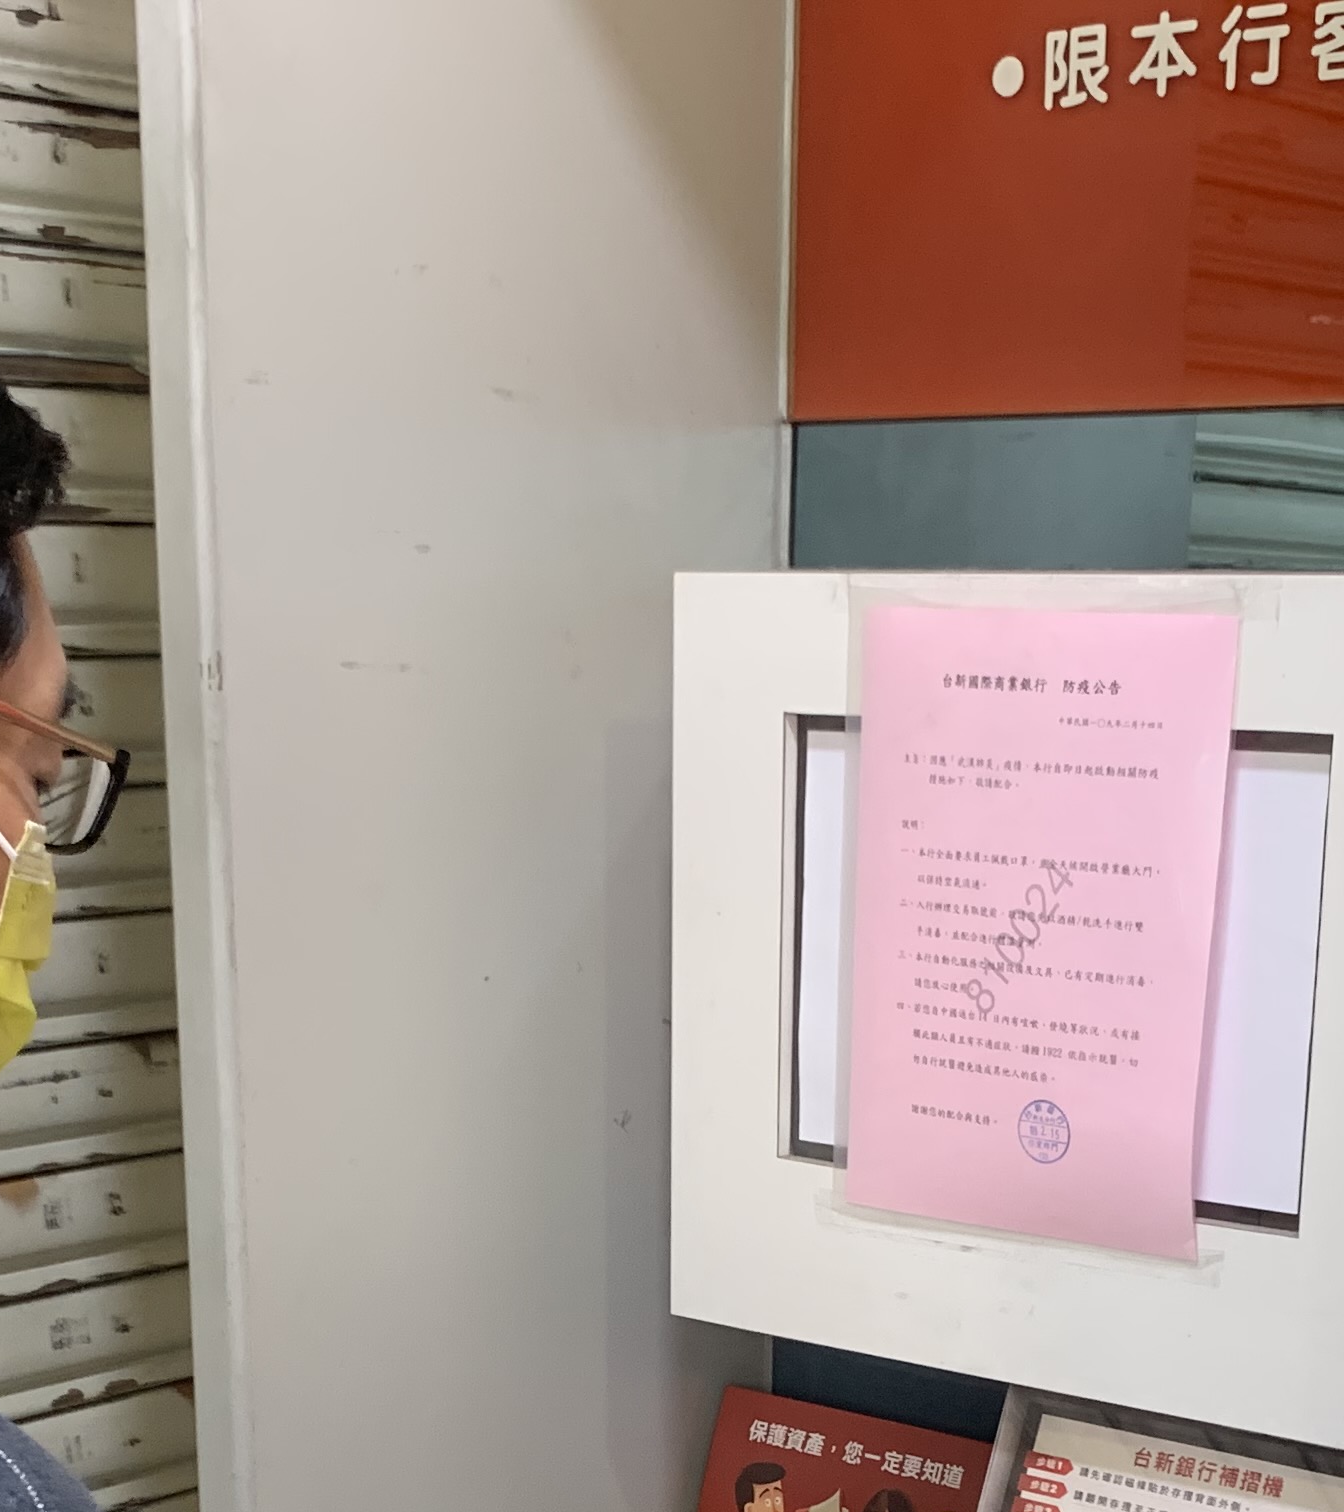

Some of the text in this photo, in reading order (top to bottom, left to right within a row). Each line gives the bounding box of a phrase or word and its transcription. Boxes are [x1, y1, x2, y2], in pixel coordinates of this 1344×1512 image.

[943, 674, 1122, 696] 台新國際商業銀行 防疫公告
[749, 1419, 965, 1490] 保護資產，您一定要知道
[1132, 1447, 1286, 1499] 台新銀行補摺機
